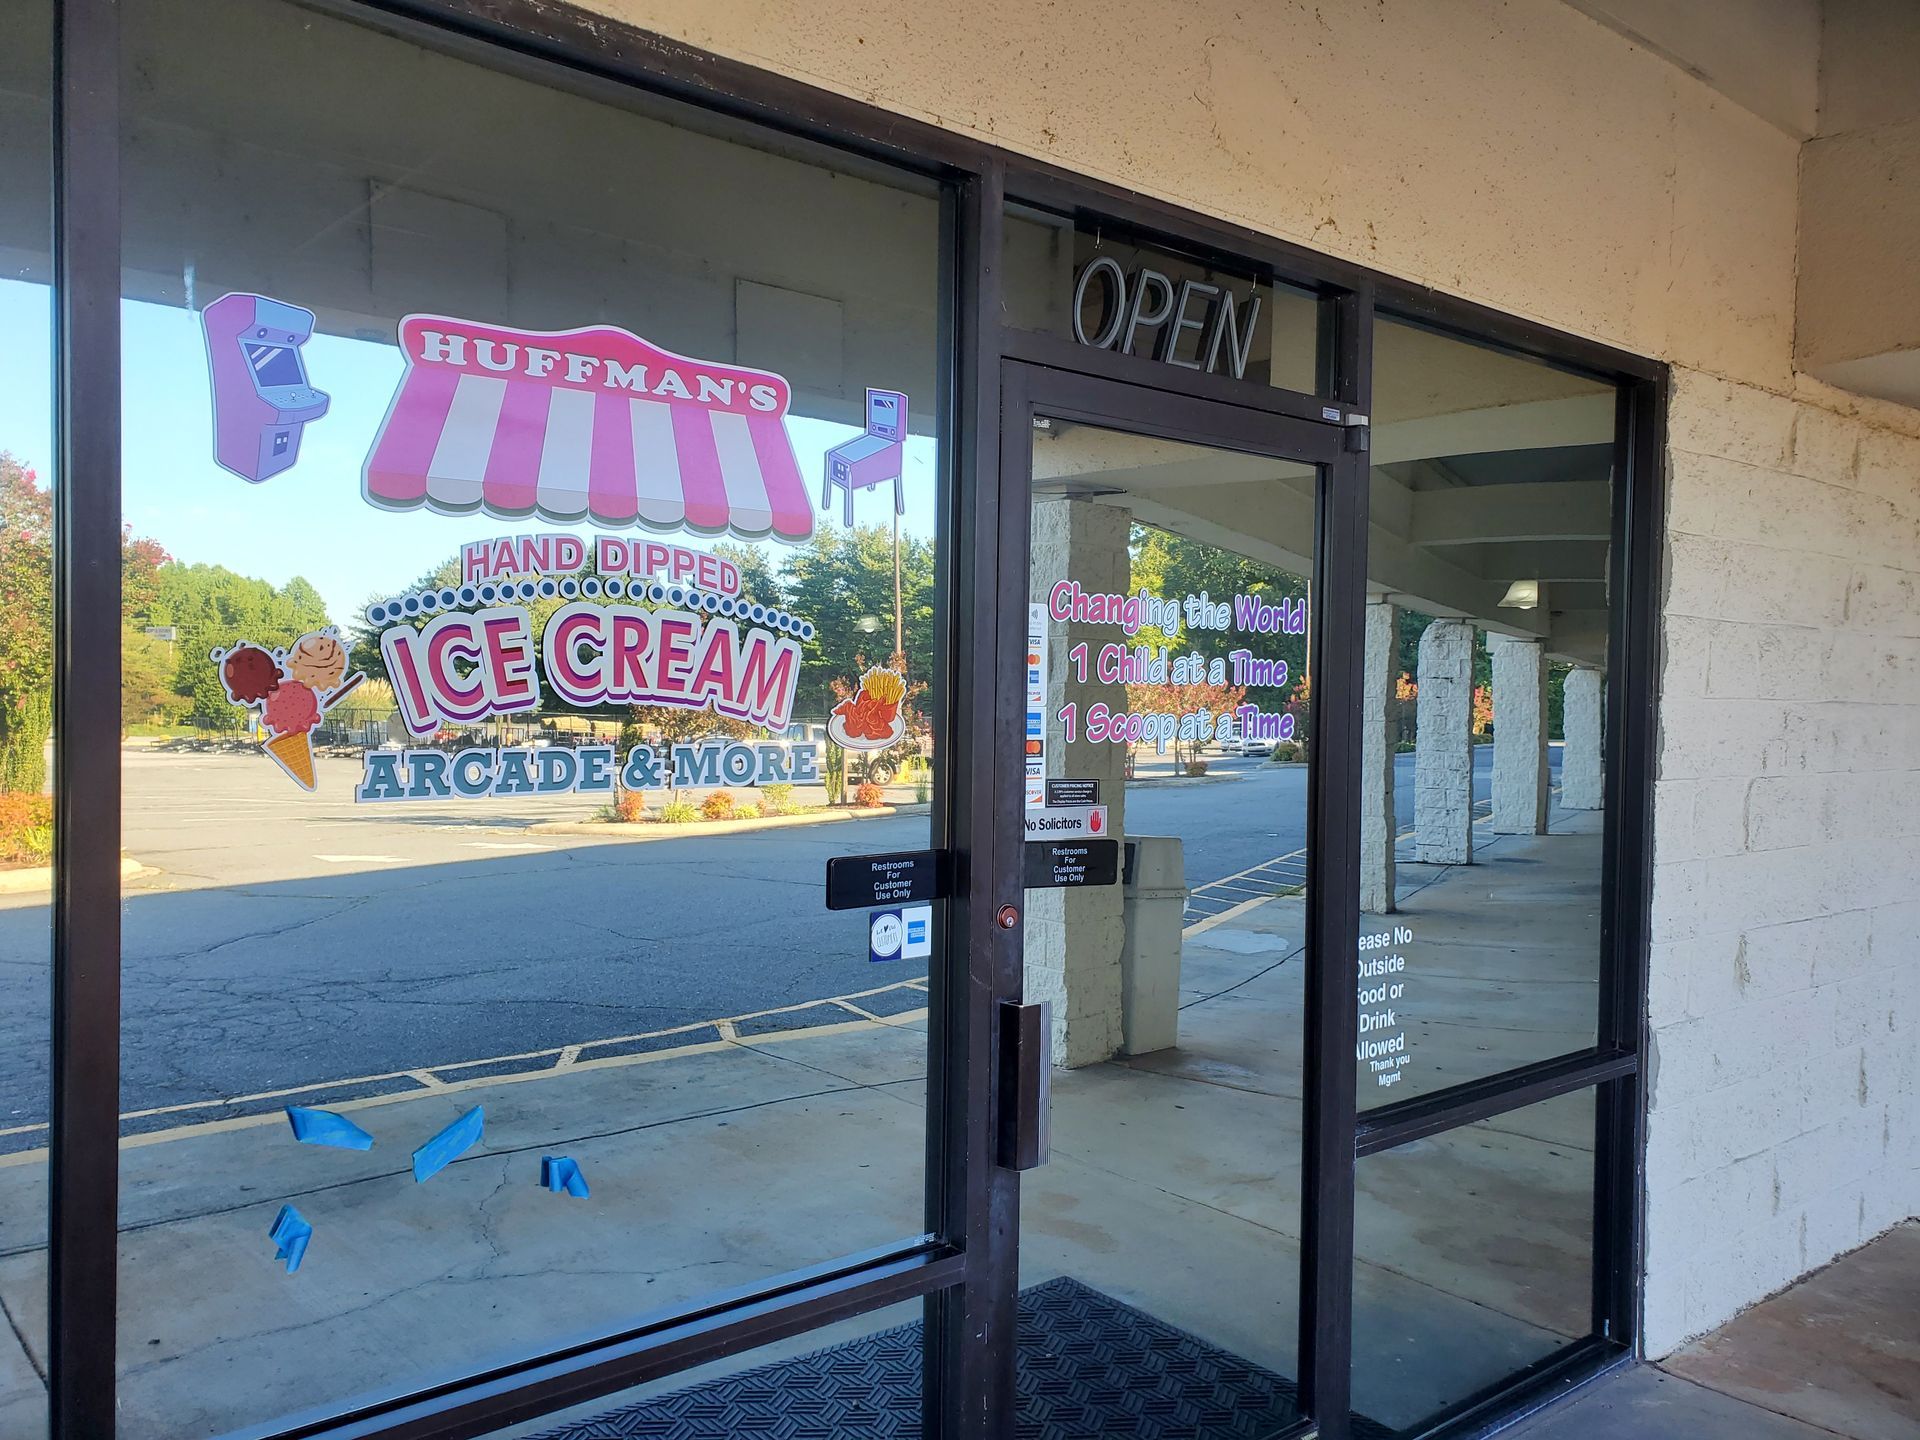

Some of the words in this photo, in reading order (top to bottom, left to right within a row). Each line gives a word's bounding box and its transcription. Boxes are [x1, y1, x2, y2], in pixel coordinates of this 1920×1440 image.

[1074, 256, 1262, 380] OPEN
[419, 330, 778, 412] HUFFMAN'S
[464, 536, 585, 585] HAND
[599, 537, 740, 596] DIPPED
[1050, 581, 1180, 637] Changing
[1184, 591, 1231, 630] the
[1235, 594, 1306, 634] World
[392, 615, 535, 726] ICE
[550, 612, 797, 724] CREAM
[1070, 642, 1089, 683] 1
[1098, 642, 1168, 685] Child
[1171, 651, 1205, 686] at
[1208, 657, 1226, 686] a
[1230, 649, 1288, 687] Time
[1058, 702, 1078, 743] 1
[1086, 702, 1178, 754] Scoop
[1179, 708, 1212, 741] at
[1215, 716, 1233, 741] a
[1237, 704, 1295, 741] Time
[361, 747, 612, 800] ARCADE
[623, 744, 662, 788] &
[674, 743, 819, 786] MORE
[1025, 767, 1041, 776] VISA
[1024, 818, 1037, 832] No
[1038, 816, 1082, 831] Solicitors
[1052, 847, 1088, 856] Restrooms
[1064, 856, 1077, 864] For
[871, 860, 915, 872] Restrooms
[886, 871, 901, 880] For
[1053, 865, 1086, 874] Customer
[873, 880, 913, 891] Customer
[1054, 874, 1068, 883] Use
[1069, 873, 1085, 883] Only
[875, 891, 891, 900] Use
[892, 888, 912, 899] Only
[1358, 932, 1391, 951] ease
[1394, 926, 1413, 946] No
[1357, 982, 1386, 1006] ood
[1389, 983, 1405, 999] or
[1359, 1008, 1396, 1033] Drink
[1369, 1056, 1395, 1073] Thank
[1395, 1054, 1411, 1069] you
[1378, 1070, 1402, 1087] Mgmt
